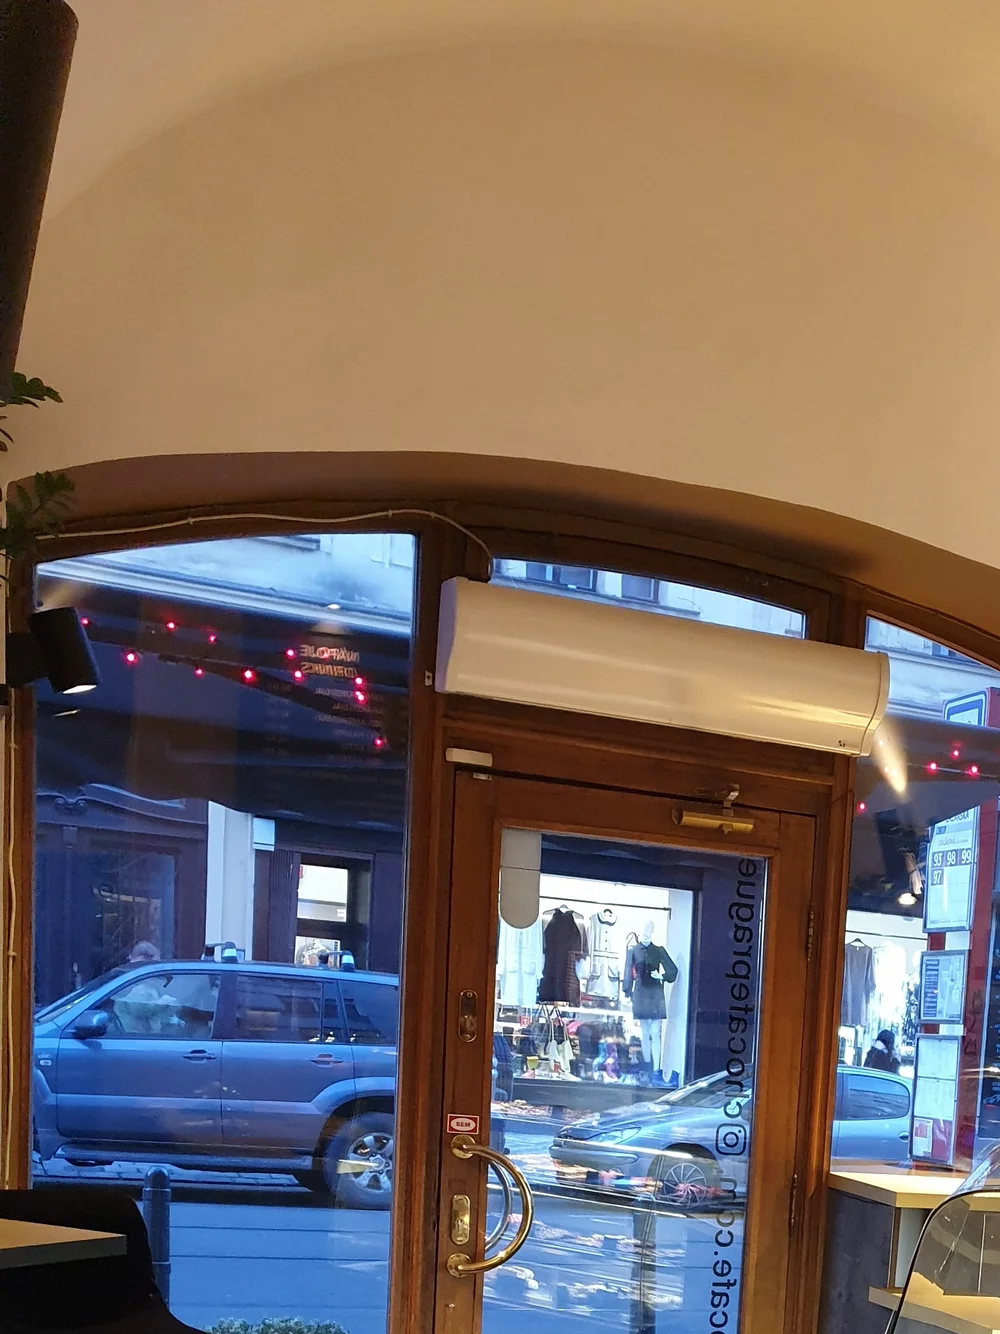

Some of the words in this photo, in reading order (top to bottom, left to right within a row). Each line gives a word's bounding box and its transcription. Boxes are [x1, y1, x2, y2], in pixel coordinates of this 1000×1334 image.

[933, 853, 943, 867] 93
[947, 851, 956, 866] 98
[961, 849, 972, 864] 99
[933, 870, 942, 884] 97
